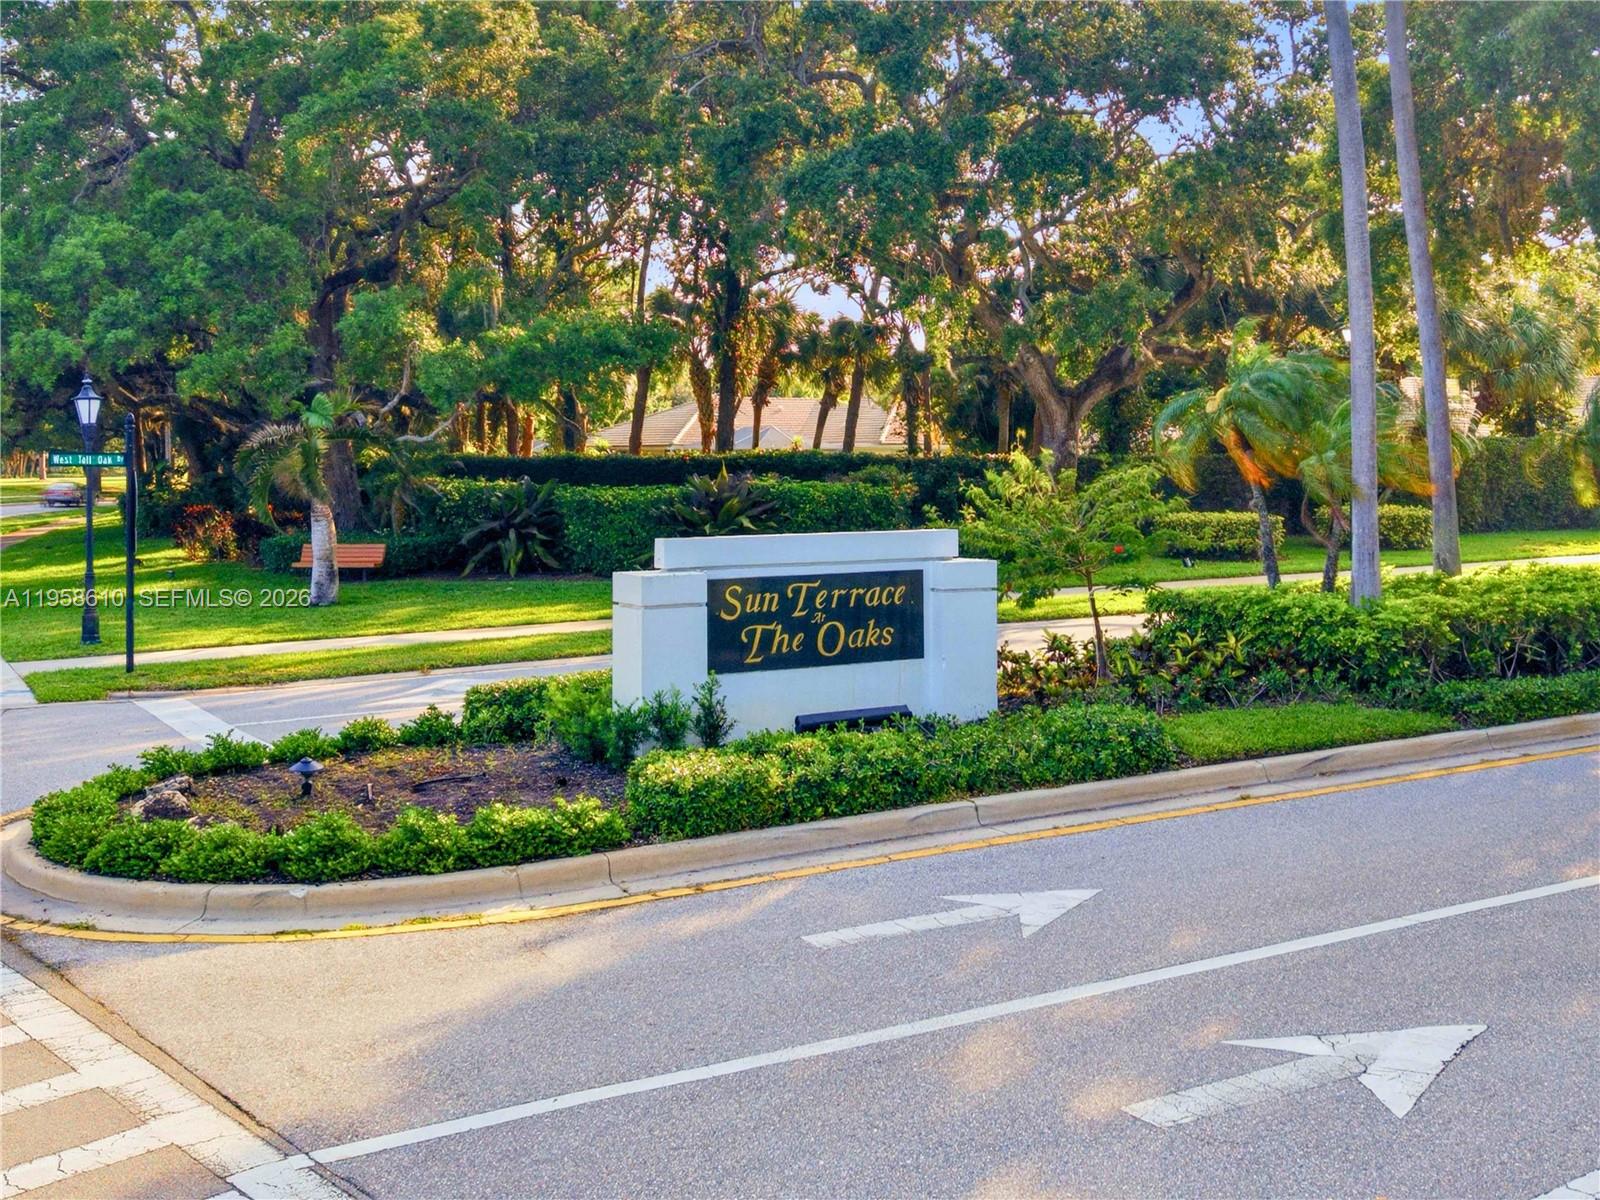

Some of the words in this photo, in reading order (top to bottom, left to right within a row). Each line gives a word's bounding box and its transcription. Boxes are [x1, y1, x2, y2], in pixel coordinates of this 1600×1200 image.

[53, 455, 72, 464] West
[97, 455, 112, 464] Oak
[719, 584, 780, 621] Sun
[786, 580, 906, 617] Terrace
[740, 621, 805, 664] The
[816, 618, 895, 657] Oaks
